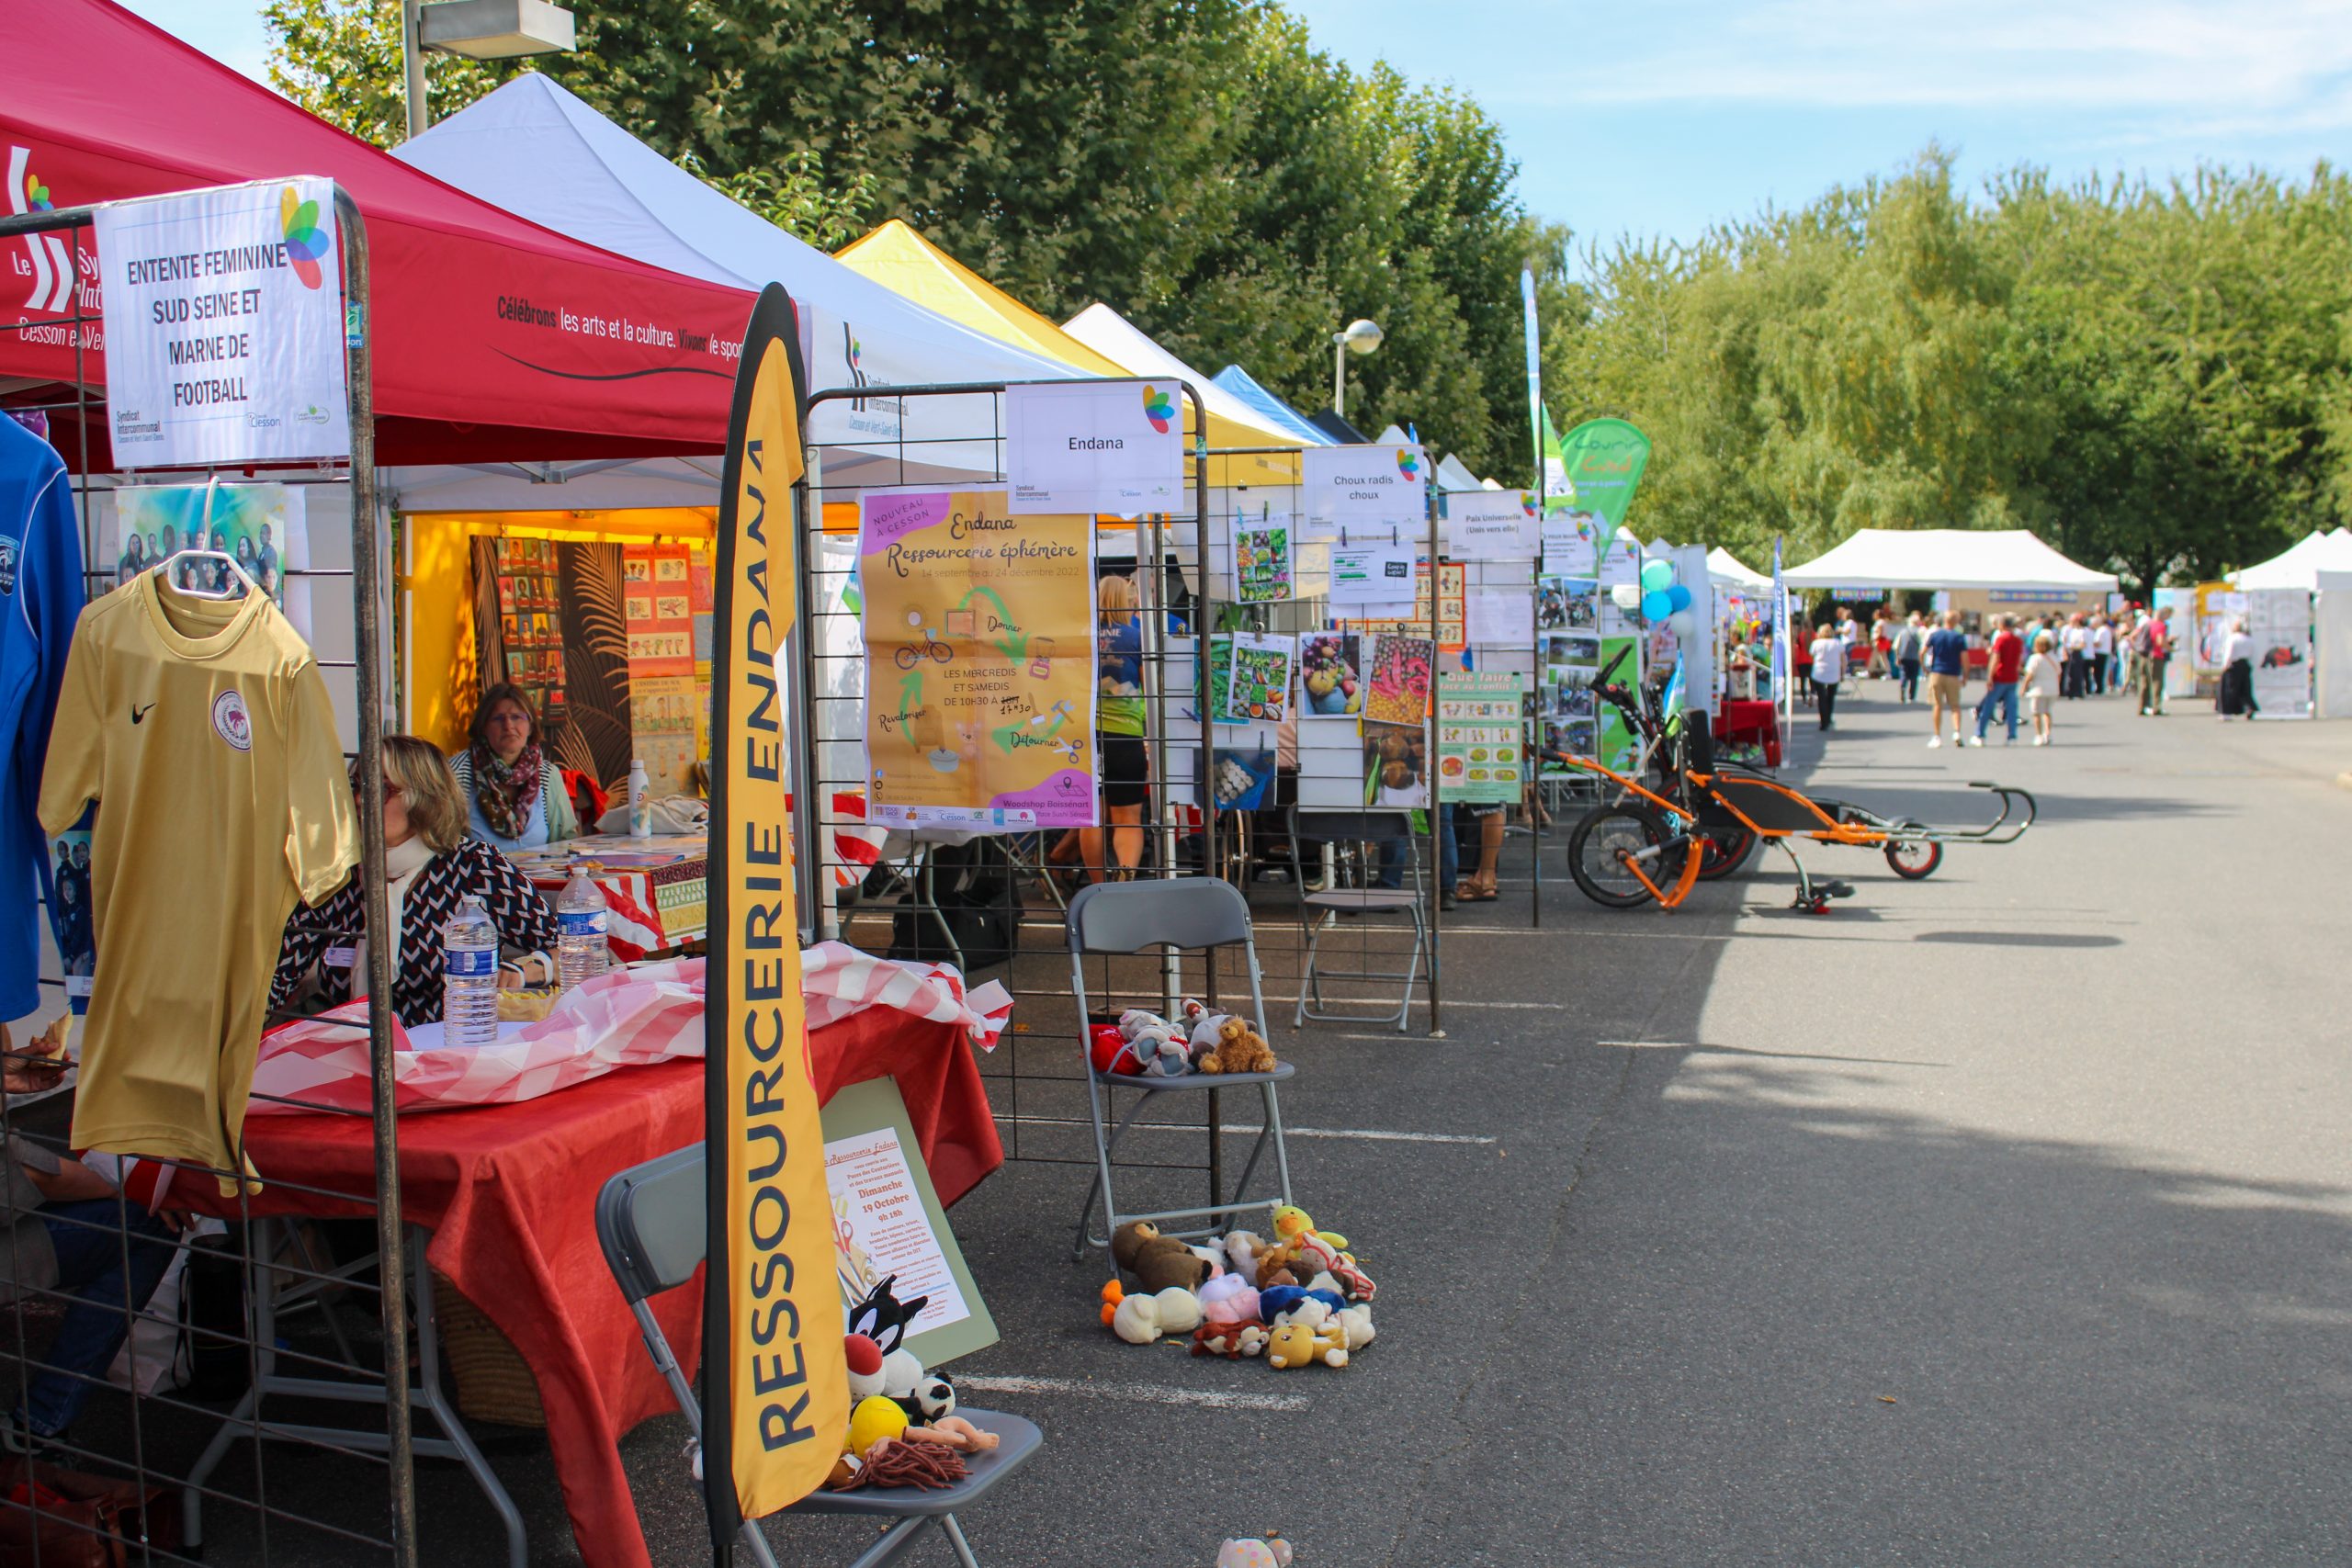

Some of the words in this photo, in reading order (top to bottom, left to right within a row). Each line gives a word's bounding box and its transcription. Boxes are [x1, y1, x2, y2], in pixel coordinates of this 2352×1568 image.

[12, 251, 31, 276] Le
[128, 254, 200, 285] ENTENTE
[204, 243, 288, 276] FEMININE
[153, 298, 189, 324] SUD
[194, 291, 238, 320] SEINE
[243, 289, 261, 314] ET
[19, 316, 66, 345] Cesson
[497, 295, 556, 327] Célébrons
[560, 307, 579, 332] les
[582, 316, 606, 337] arts
[609, 320, 620, 339] et
[624, 318, 633, 342] la
[636, 323, 676, 349] culture.
[678, 328, 707, 352] Vivons
[721, 341, 743, 361] spor
[169, 336, 224, 365] MARNE
[230, 333, 249, 359] DE
[174, 377, 248, 407] FOOTBALL
[117, 410, 140, 423] Syndicat
[118, 421, 161, 434] Intercommunal
[1069, 436, 1124, 451] Endana
[1334, 475, 1366, 485] Choux
[1368, 475, 1394, 485] radis
[1349, 490, 1379, 500] choux
[873, 499, 924, 526] NOUVEAU
[888, 509, 929, 533] CESSON
[1482, 513, 1522, 522] Universelle
[950, 511, 1017, 540] Endana
[1466, 526, 1485, 535] (Unis
[885, 542, 995, 578] Ressourcerie
[1000, 539, 1078, 568] éphémère
[922, 569, 933, 578] 14
[935, 569, 981, 580] septembre
[995, 568, 1007, 577] 24
[1010, 568, 1054, 577] décembre
[1057, 567, 1080, 576] 2022
[988, 615, 1022, 632] Donner
[944, 670, 961, 678] LES
[963, 668, 1017, 678] MERCREDIS
[1447, 672, 1474, 682] Que
[1480, 672, 1512, 682] faire
[954, 683, 965, 692] ET
[968, 682, 1010, 691] SAMEDIS
[944, 697, 957, 706] DE
[961, 697, 988, 705] 10H30
[991, 695, 998, 705] À
[878, 708, 927, 732] Revaloriser
[1010, 731, 1059, 748] Détourner
[1003, 800, 1045, 808] Woodshop
[1048, 799, 1089, 807] Boissénart
[940, 813, 966, 821] Cesson
[744, 821, 815, 1452] RESSOURCERIE
[830, 1148, 871, 1165] Ressourcerie
[873, 1141, 898, 1156] Endana
[858, 1181, 903, 1199] Dimanche
[862, 1204, 873, 1213] 19
[874, 1194, 909, 1209] Octobre
[878, 1214, 888, 1222] 9h
[890, 1209, 903, 1218] 18h
